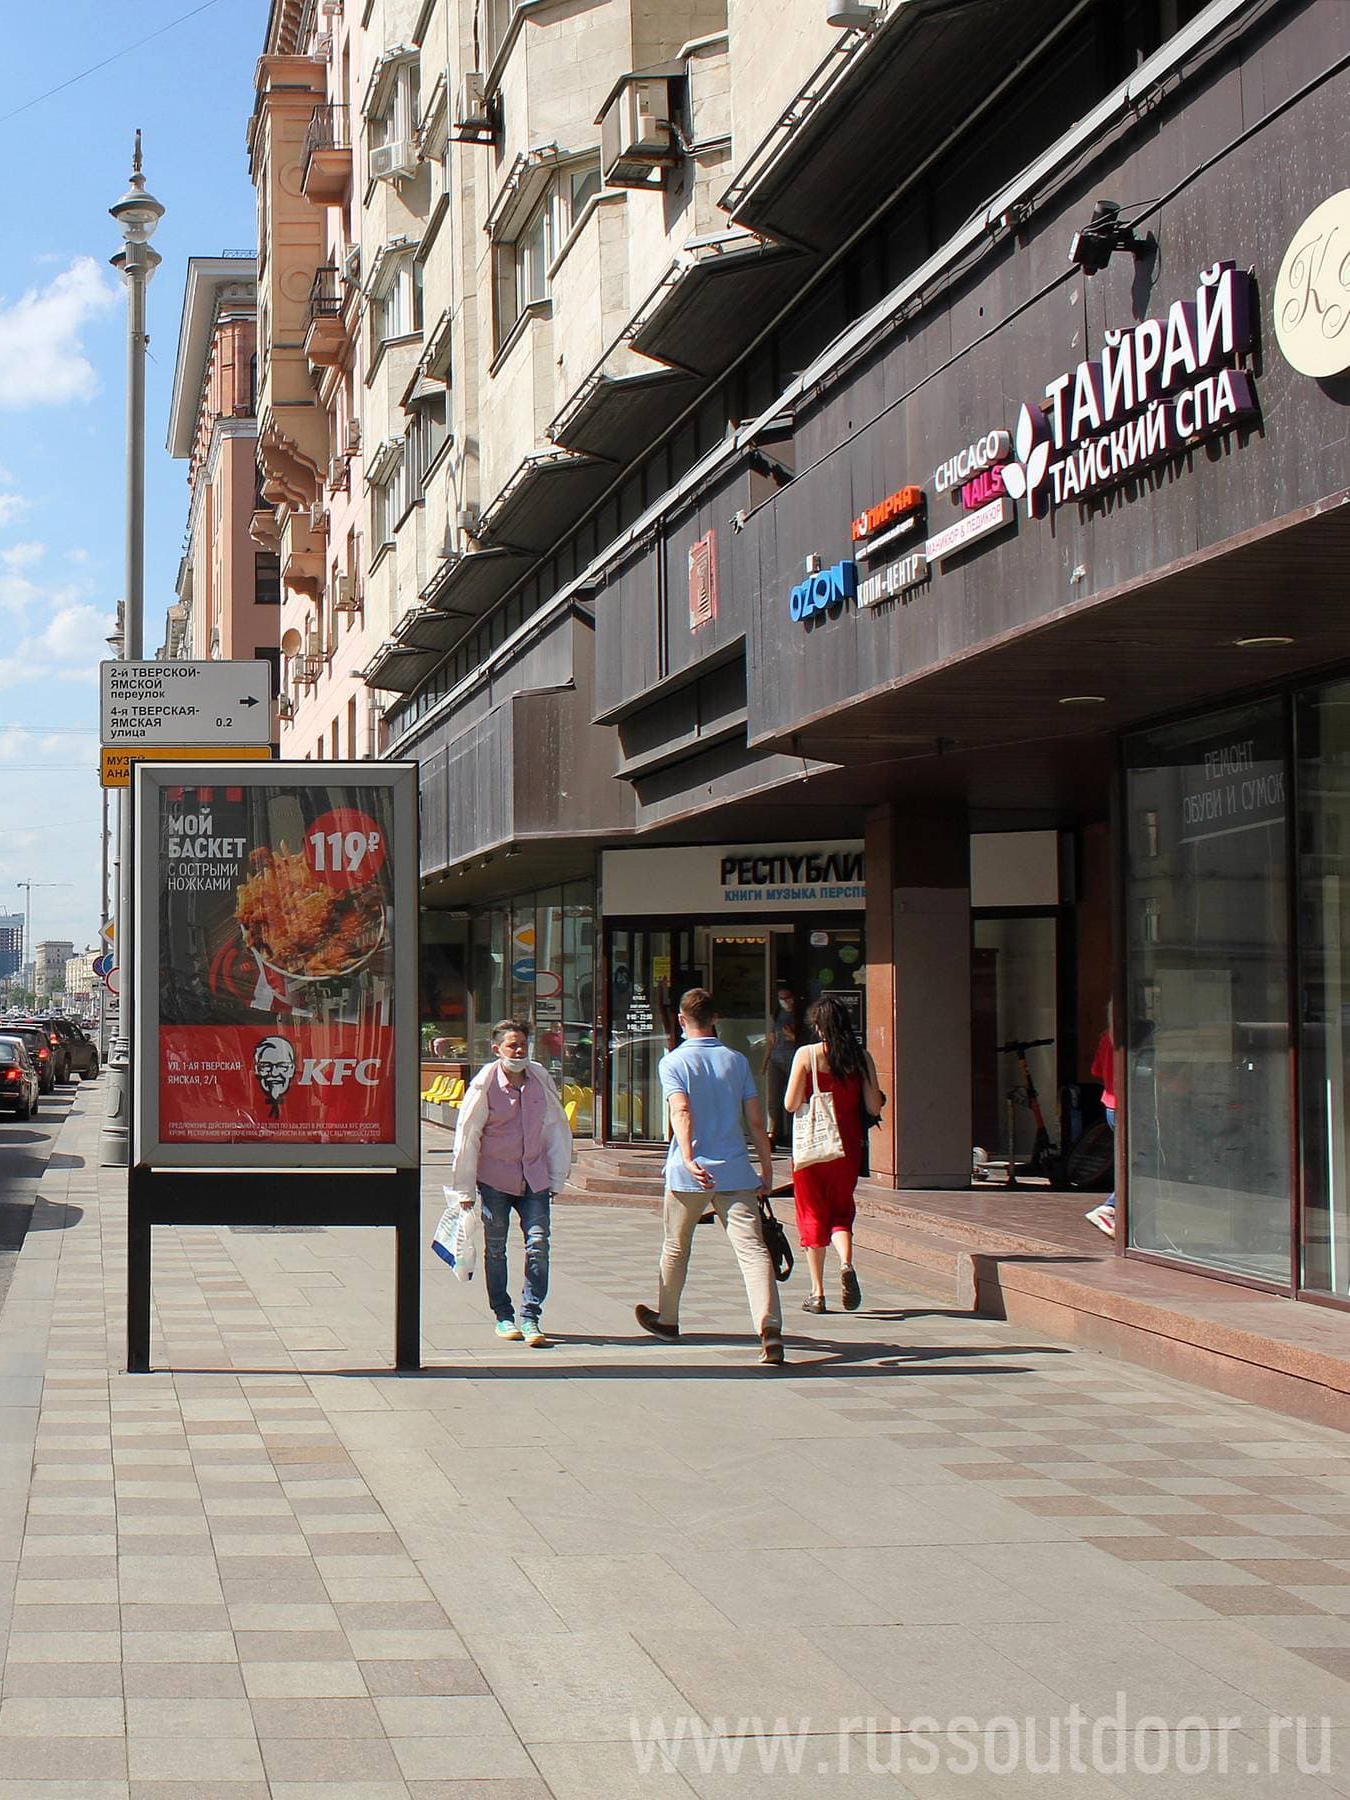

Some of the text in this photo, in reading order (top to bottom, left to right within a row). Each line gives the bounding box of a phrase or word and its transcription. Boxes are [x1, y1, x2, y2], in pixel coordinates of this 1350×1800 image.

[1045, 260, 1235, 450] ТАЙРАЙ
[1049, 370, 1237, 504] ТАЙСКИЙ СПА
[935, 430, 1006, 493] CHICAGO
[961, 465, 1004, 511] NAILS
[967, 504, 1003, 535] ПЕДИКЮР
[857, 553, 920, 609] КОПИ-ЦЕНТР
[789, 561, 849, 622] OZON
[132, 667, 201, 678] ТВЕРСКОЙ-
[110, 678, 162, 689] ЯМСКОЙ
[110, 690, 165, 700] переулок
[110, 706, 200, 716] 4-я ТВЕРСКАЯ-
[110, 718, 162, 728] ЯМСКАЯ
[216, 718, 233, 728] 0.2
[110, 729, 146, 739] улица
[1204, 740, 1254, 781] РЕМОНТ
[1183, 772, 1286, 824] ОБУВИ И СУМОК
[168, 807, 213, 835] МОЙ
[168, 838, 247, 858] БАСКЕТ
[168, 863, 239, 877] С ОСТРЫМИ
[168, 877, 231, 891] НОЖКАМИ
[724, 888, 762, 902] КНИГИ
[766, 887, 817, 900] МУЗЫКА
[201, 1062, 244, 1071] ТВЕРСКАЯ-
[298, 1058, 382, 1086] KFC
[204, 1076, 218, 1086] 2/1
